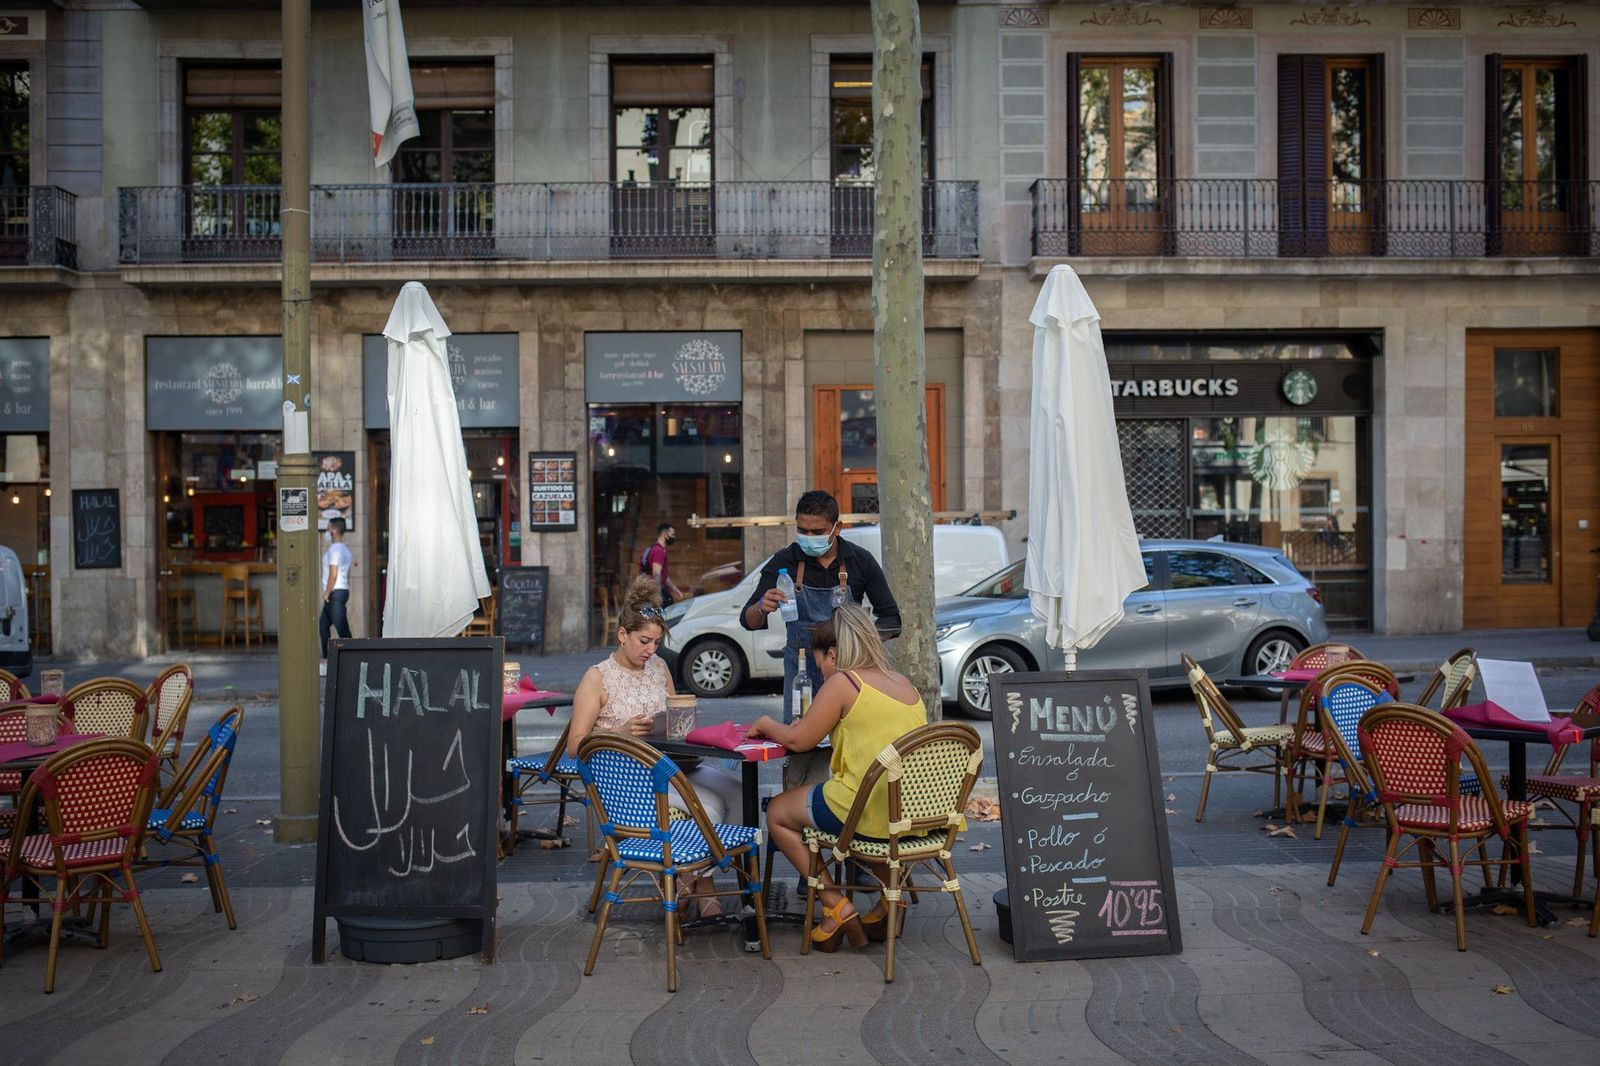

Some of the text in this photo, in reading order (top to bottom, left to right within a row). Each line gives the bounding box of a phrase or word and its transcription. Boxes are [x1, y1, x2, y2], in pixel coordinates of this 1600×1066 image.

[155, 378, 200, 390] restaurant
[1112, 378, 1239, 397] TARBUCKS
[4, 401, 32, 415] & bar
[468, 398, 476, 410] &
[480, 397, 496, 410] bar
[318, 471, 343, 480] APA
[318, 481, 351, 489] AELLA
[80, 495, 116, 510] HALAL
[356, 661, 492, 720] HALAL
[1018, 742, 1117, 768] Ensalada
[1066, 768, 1080, 781] ó
[1020, 782, 1112, 812] Gazpacho
[1027, 824, 1109, 849] Pollo ó
[1028, 848, 1106, 875] Pescado
[1031, 882, 1087, 908] Postre
[1097, 889, 1164, 928] 10'95
